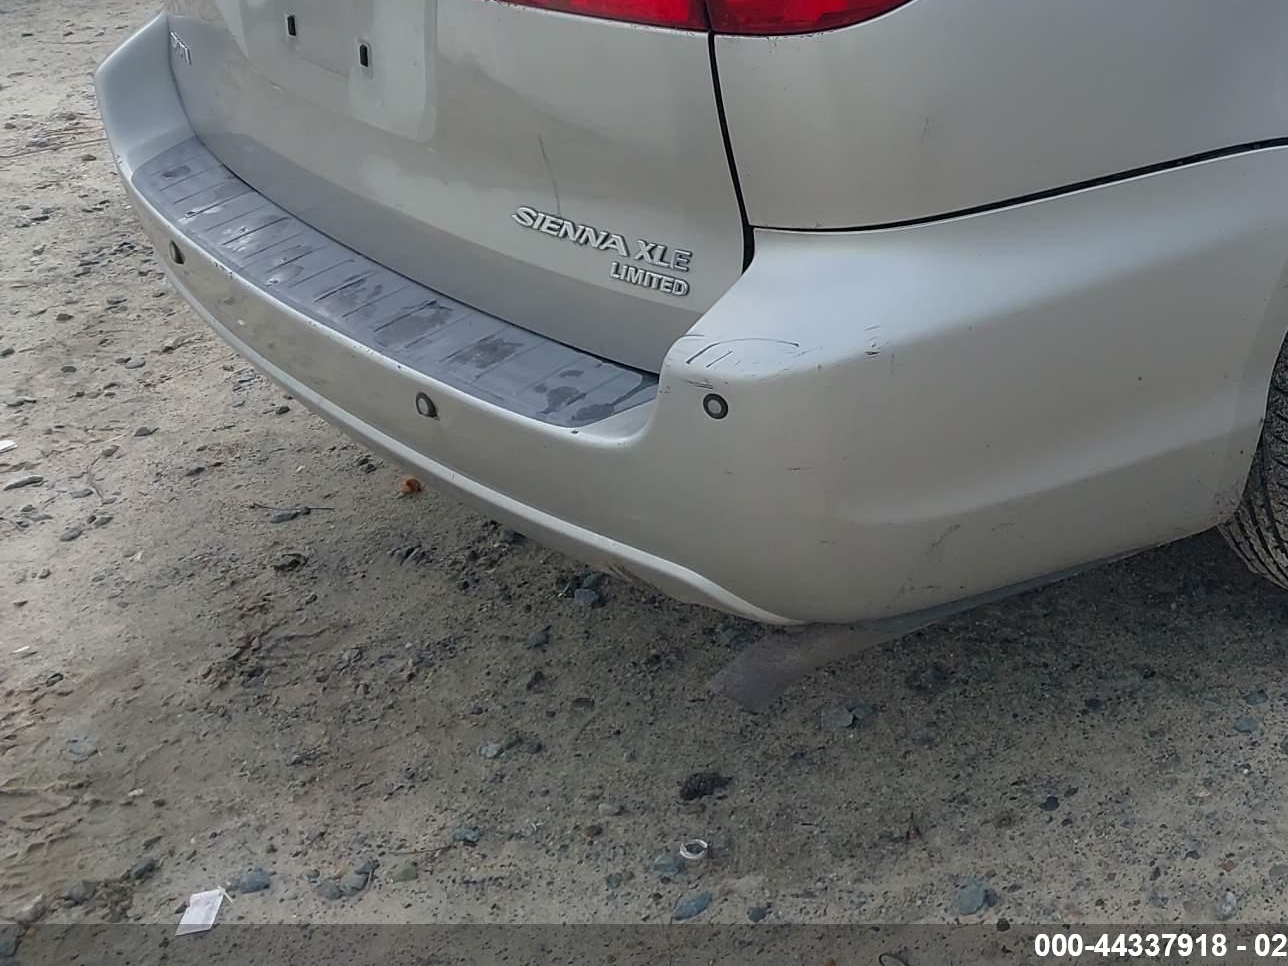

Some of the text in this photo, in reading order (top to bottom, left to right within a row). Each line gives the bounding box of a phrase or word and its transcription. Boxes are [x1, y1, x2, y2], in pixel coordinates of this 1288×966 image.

[511, 205, 693, 272] SIENNA XLE
[609, 261, 690, 296] LIMITED
